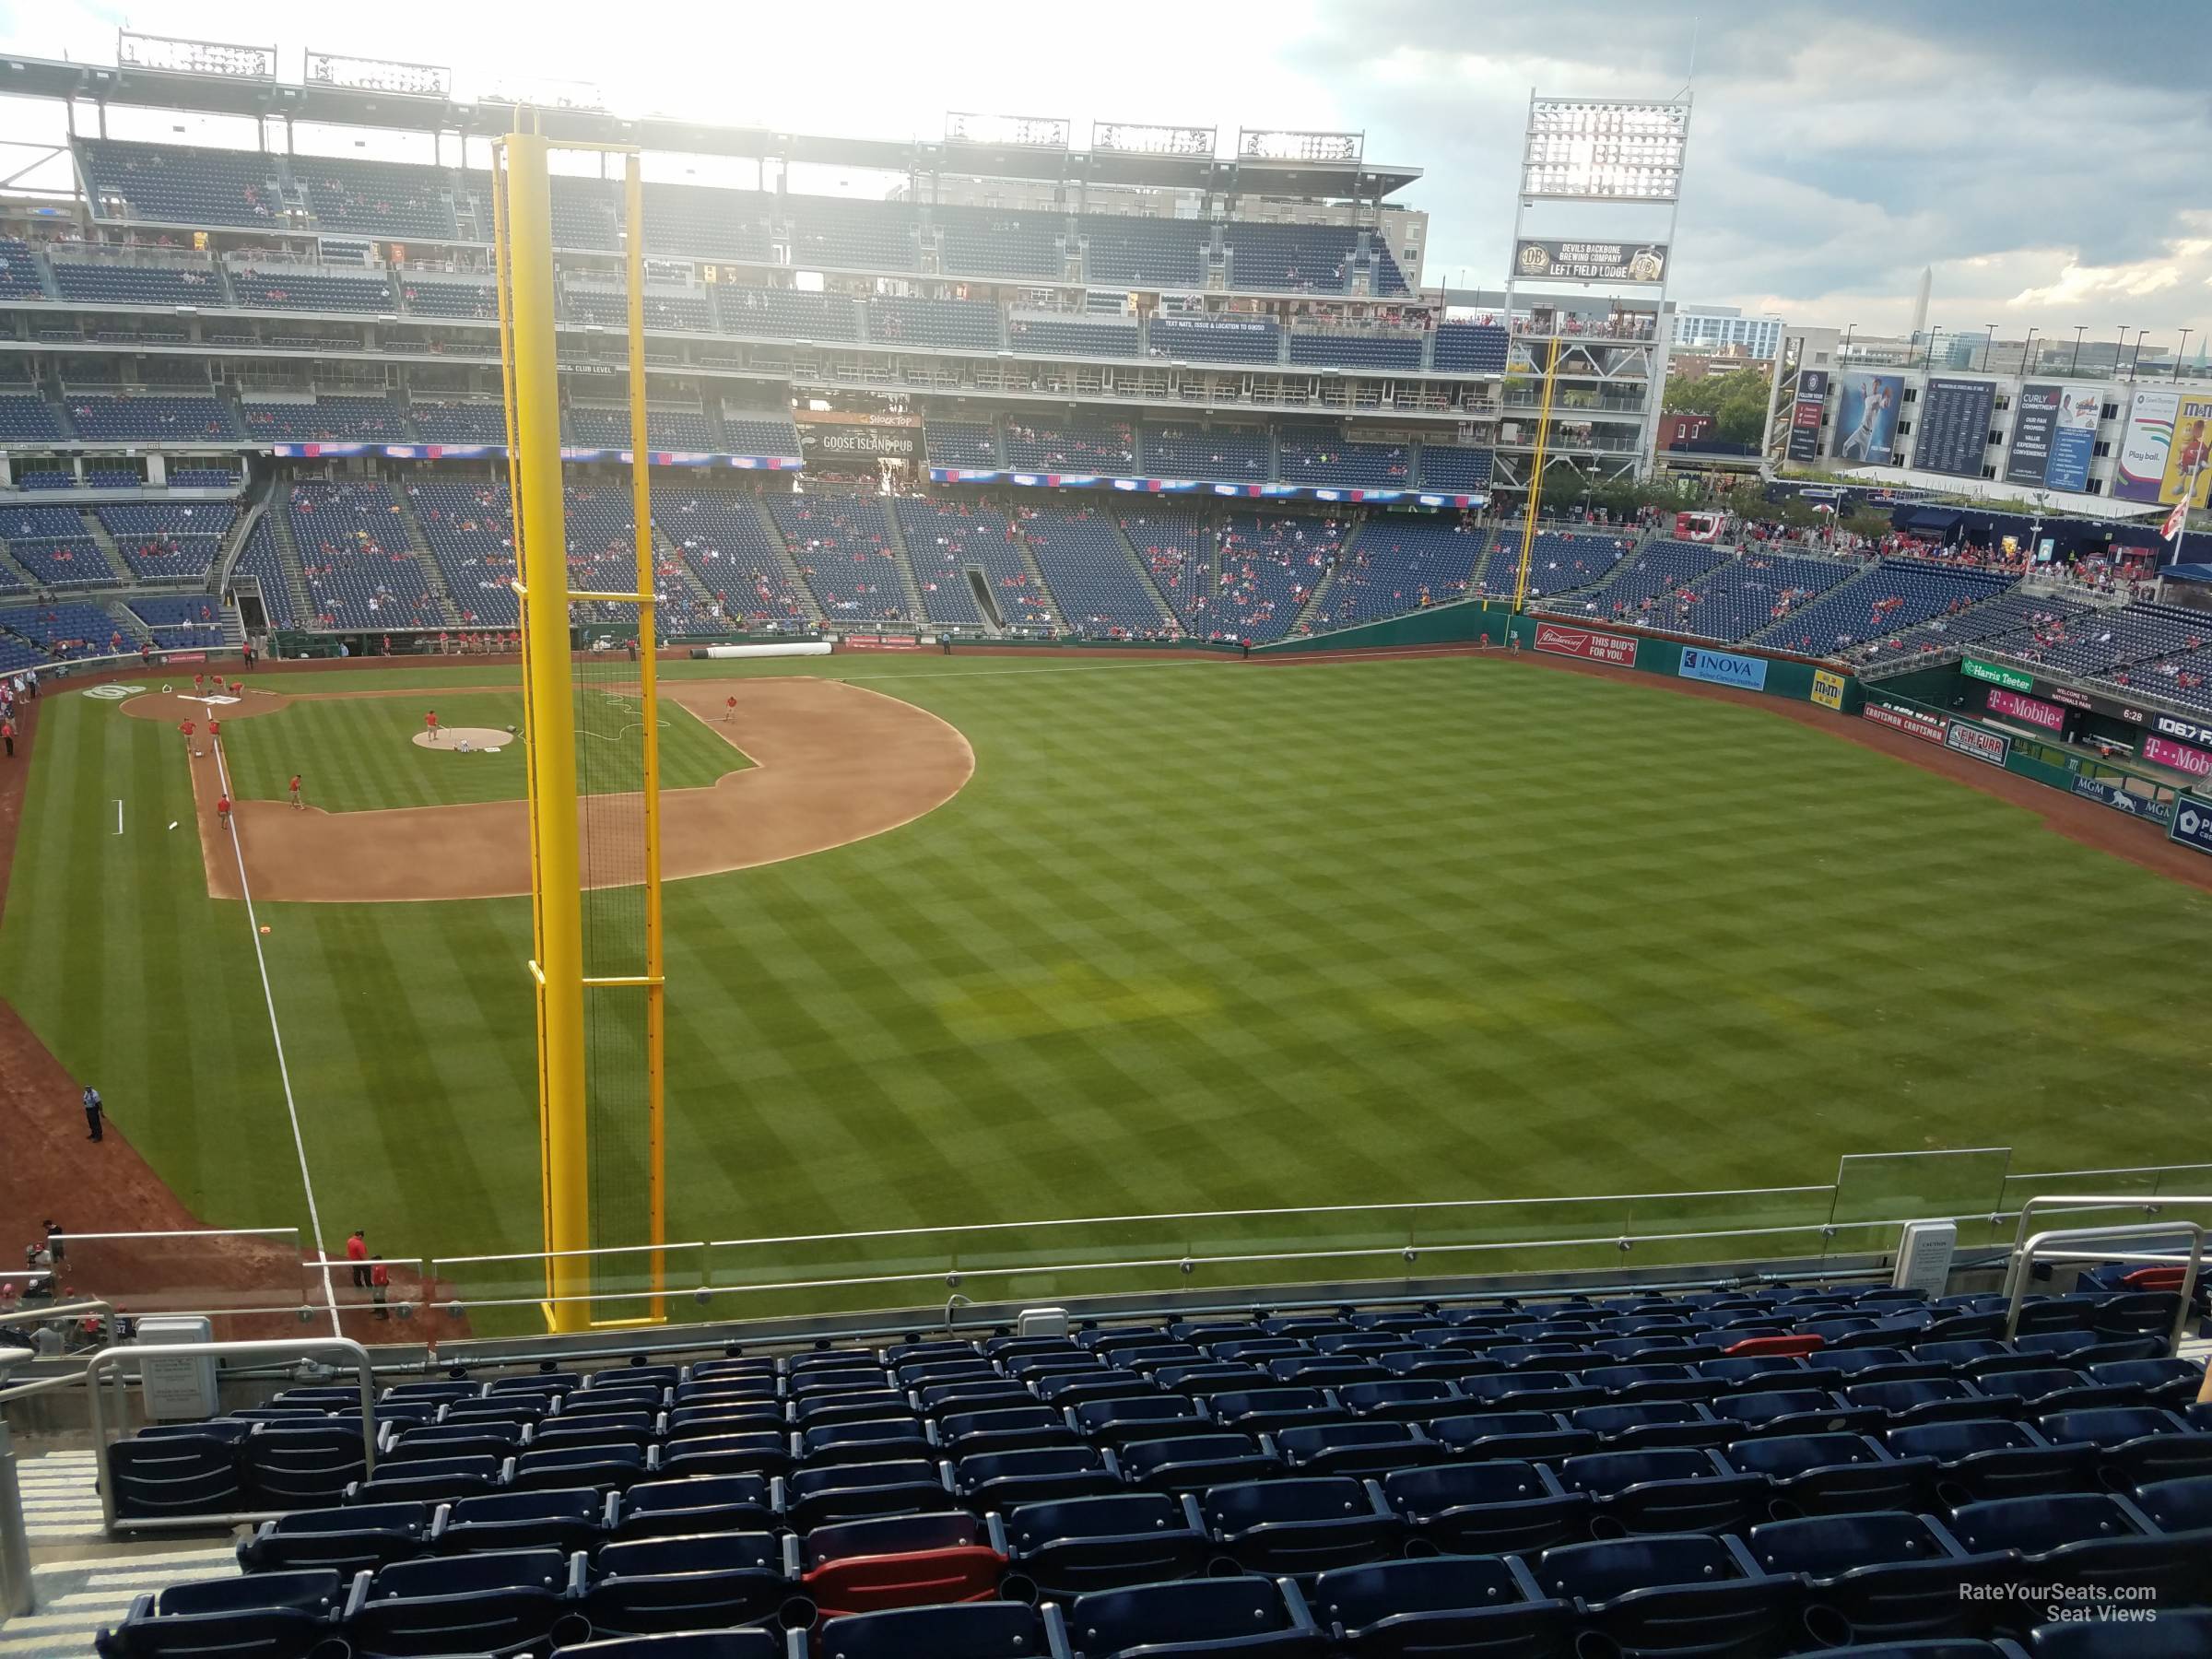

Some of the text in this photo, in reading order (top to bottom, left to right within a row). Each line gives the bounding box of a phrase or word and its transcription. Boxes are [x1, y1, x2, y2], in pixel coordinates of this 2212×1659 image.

[1562, 243, 1621, 254] DEVILS BACKBONE
[1559, 253, 1621, 263] BREWING COMPANY
[1550, 265, 1571, 276] LEFT
[1573, 265, 1597, 276] FIELD
[1599, 265, 1628, 277] LODGE
[2023, 394, 2048, 404] CURLY
[824, 436, 912, 452] GOOSE ISLAND PUB
[2017, 441, 2046, 450] EXPERIENCE
[2013, 449, 2047, 457] CONVENIENCE
[2128, 450, 2160, 461] Play ball.
[1543, 632, 1582, 646] Budweiser
[1592, 636, 1634, 652] THIS BUD'S
[1590, 646, 1624, 661] FOR YOU.
[1701, 655, 1751, 676] INOVA
[1973, 665, 2030, 689] Harris Teeter
[2056, 688, 2080, 700] WELCOME
[2052, 694, 2091, 710] NATIONALS PARK
[2124, 709, 2143, 722] 6:28
[1865, 707, 1942, 740] CRAFTSMAN CRAFTSMAN
[1976, 734, 2002, 753] FURR
[2078, 777, 2104, 794] MGM
